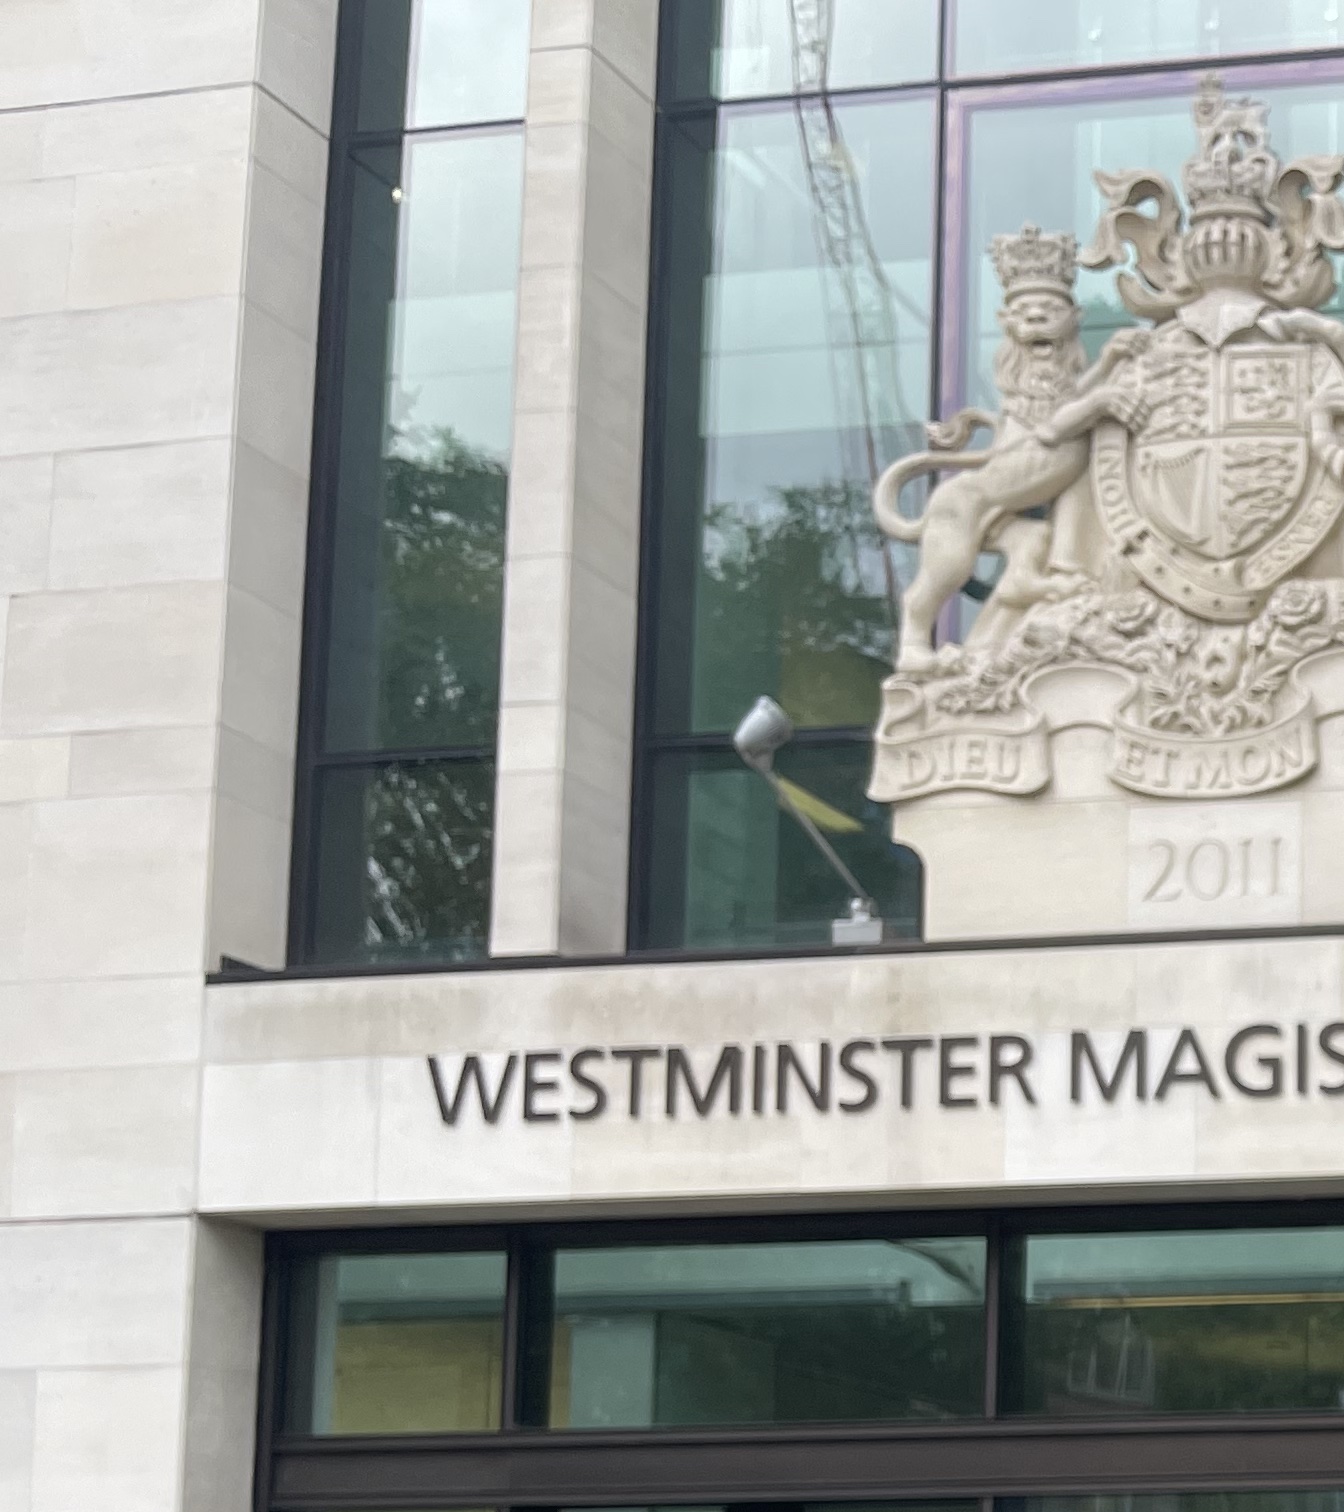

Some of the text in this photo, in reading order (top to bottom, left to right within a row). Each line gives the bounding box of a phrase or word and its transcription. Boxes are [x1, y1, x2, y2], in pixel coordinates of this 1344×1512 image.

[899, 739, 1020, 792] DIEU
[1117, 738, 1180, 789] ET
[1184, 728, 1304, 790] MON
[1142, 837, 1282, 902] 2011
[427, 1035, 1036, 1126] WESTMINSTER
